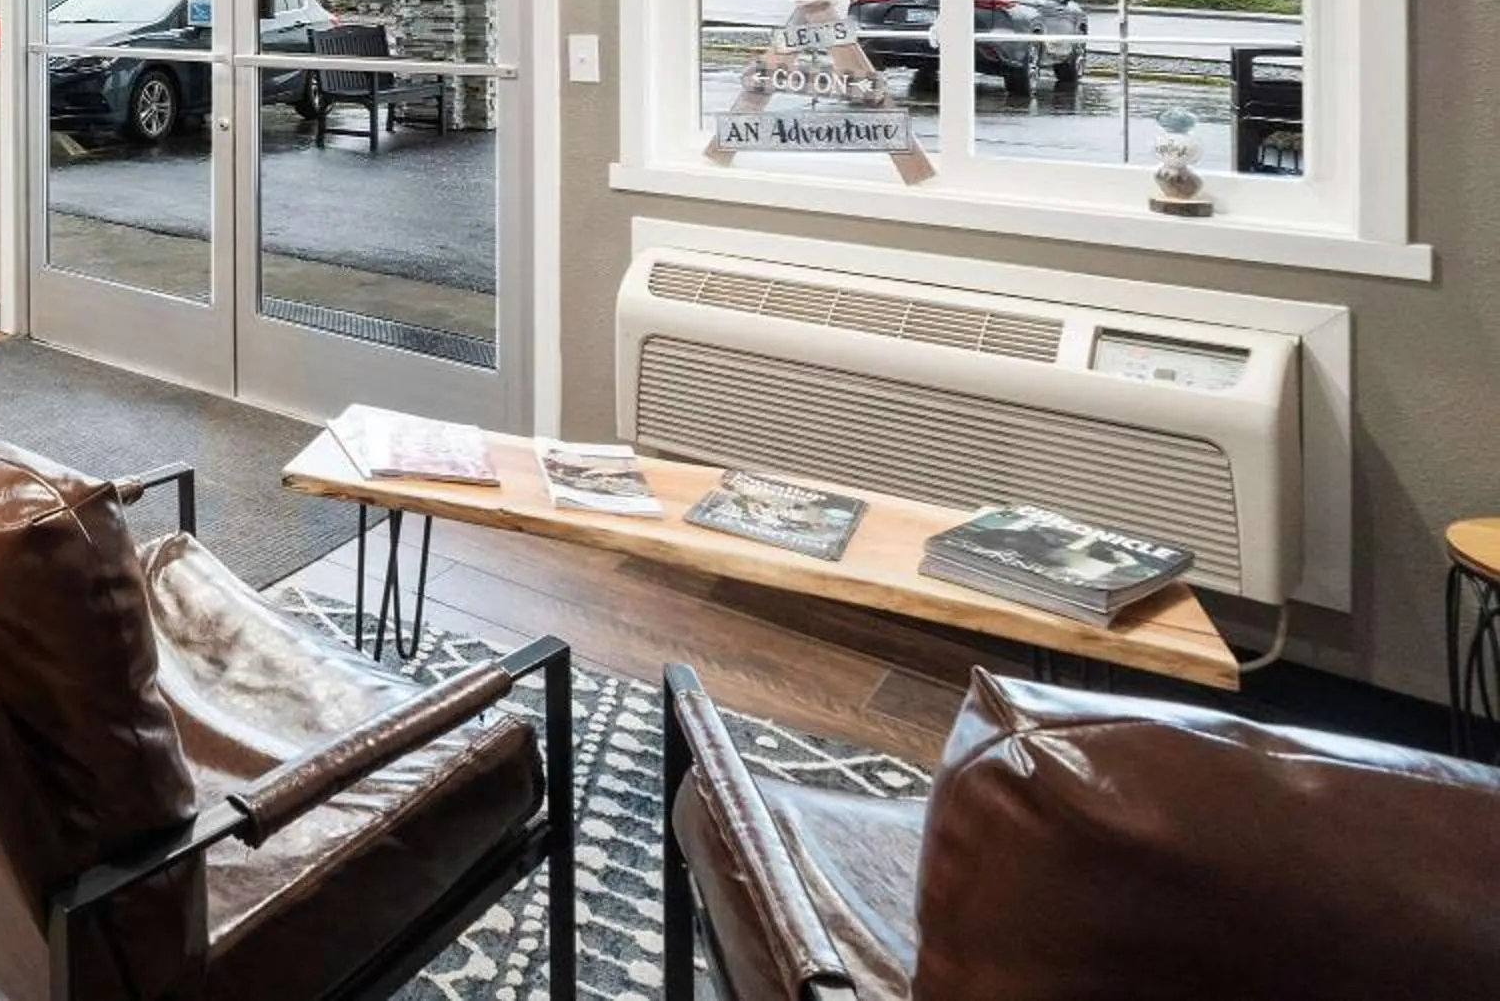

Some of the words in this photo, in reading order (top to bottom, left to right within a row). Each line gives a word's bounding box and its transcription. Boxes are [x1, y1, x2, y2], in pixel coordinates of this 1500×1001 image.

[782, 22, 848, 48] LET'S
[772, 68, 806, 91] GO
[813, 72, 849, 95] ON
[726, 121, 761, 143] AN
[771, 118, 900, 145] Adventure
